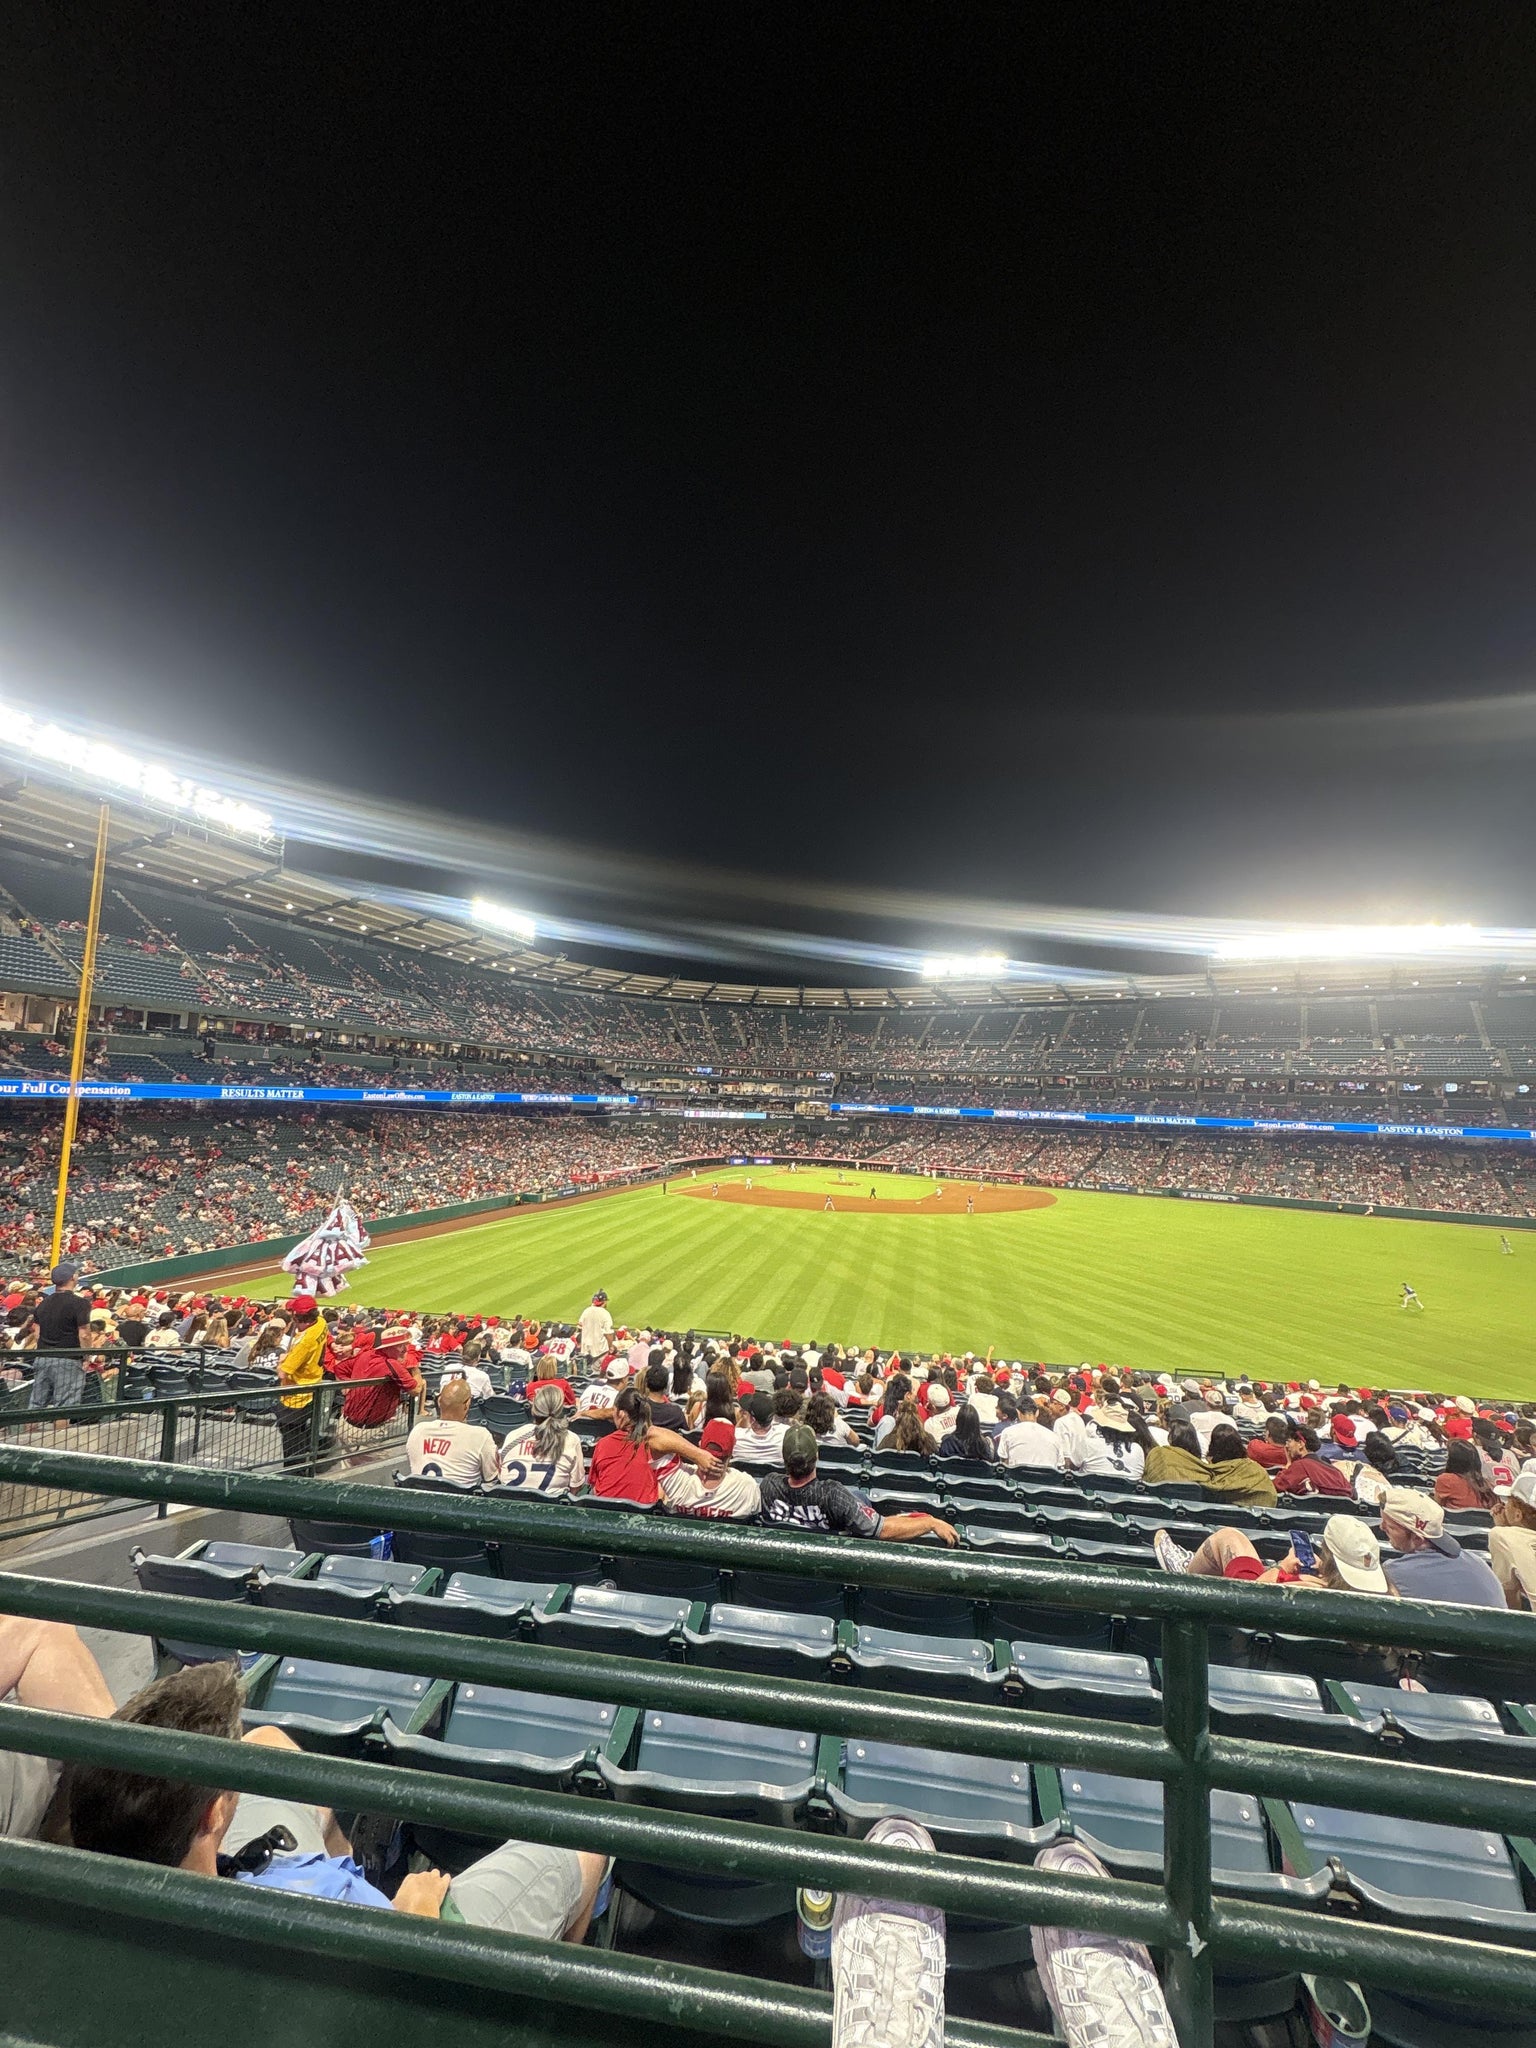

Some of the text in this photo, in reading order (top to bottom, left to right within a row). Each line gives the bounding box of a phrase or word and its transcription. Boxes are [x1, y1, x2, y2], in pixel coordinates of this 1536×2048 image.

[0, 1085, 19, 1093] our
[21, 1083, 46, 1094] Full
[221, 1088, 304, 1098] RESULTS MATTER
[1254, 1121, 1335, 1130] EastonLawOffices.com
[1425, 1127, 1464, 1135] EASTON
[550, 1343, 567, 1355] 28
[591, 1392, 610, 1408] NETO
[940, 1416, 956, 1430] TROU
[423, 1438, 451, 1456] NETO
[507, 1461, 556, 1491] 27
[1415, 1514, 1430, 1531] W
